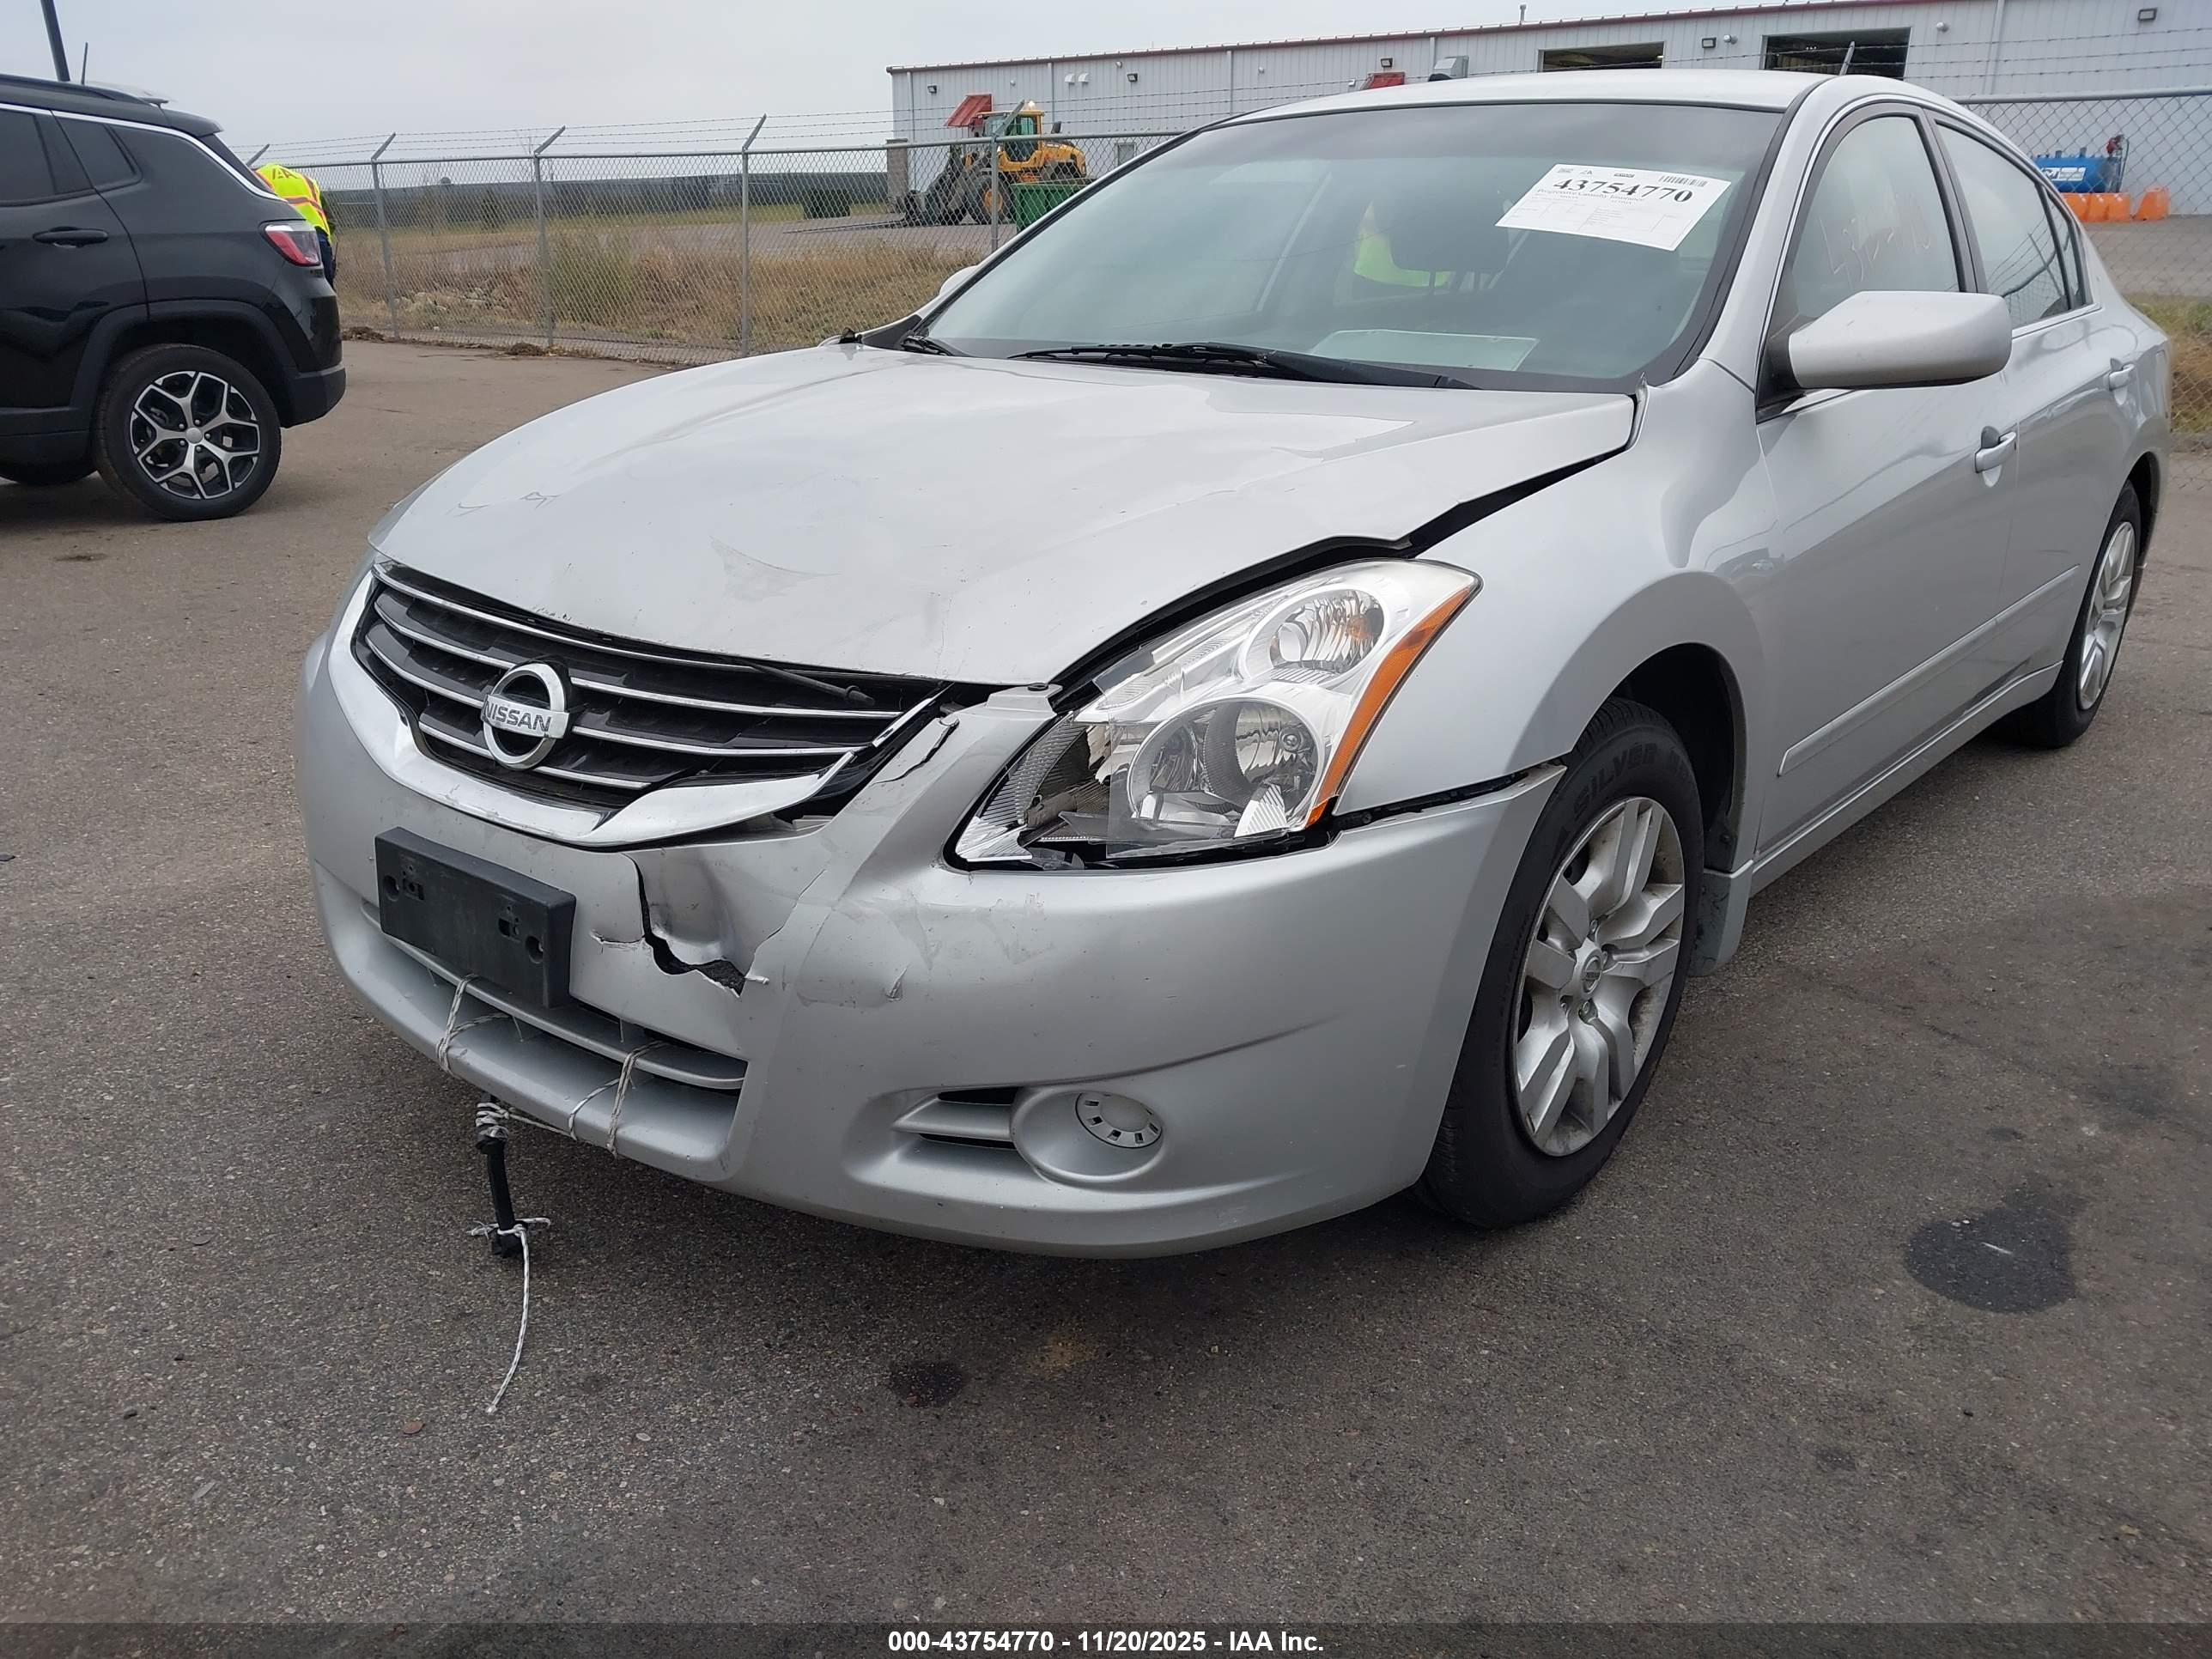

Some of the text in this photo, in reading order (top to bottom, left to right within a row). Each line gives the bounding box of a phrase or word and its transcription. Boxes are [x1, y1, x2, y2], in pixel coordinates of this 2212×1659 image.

[1553, 179, 1693, 202] 43754770
[484, 701, 552, 732] NISSAN
[1572, 741, 1658, 820] SILVER
